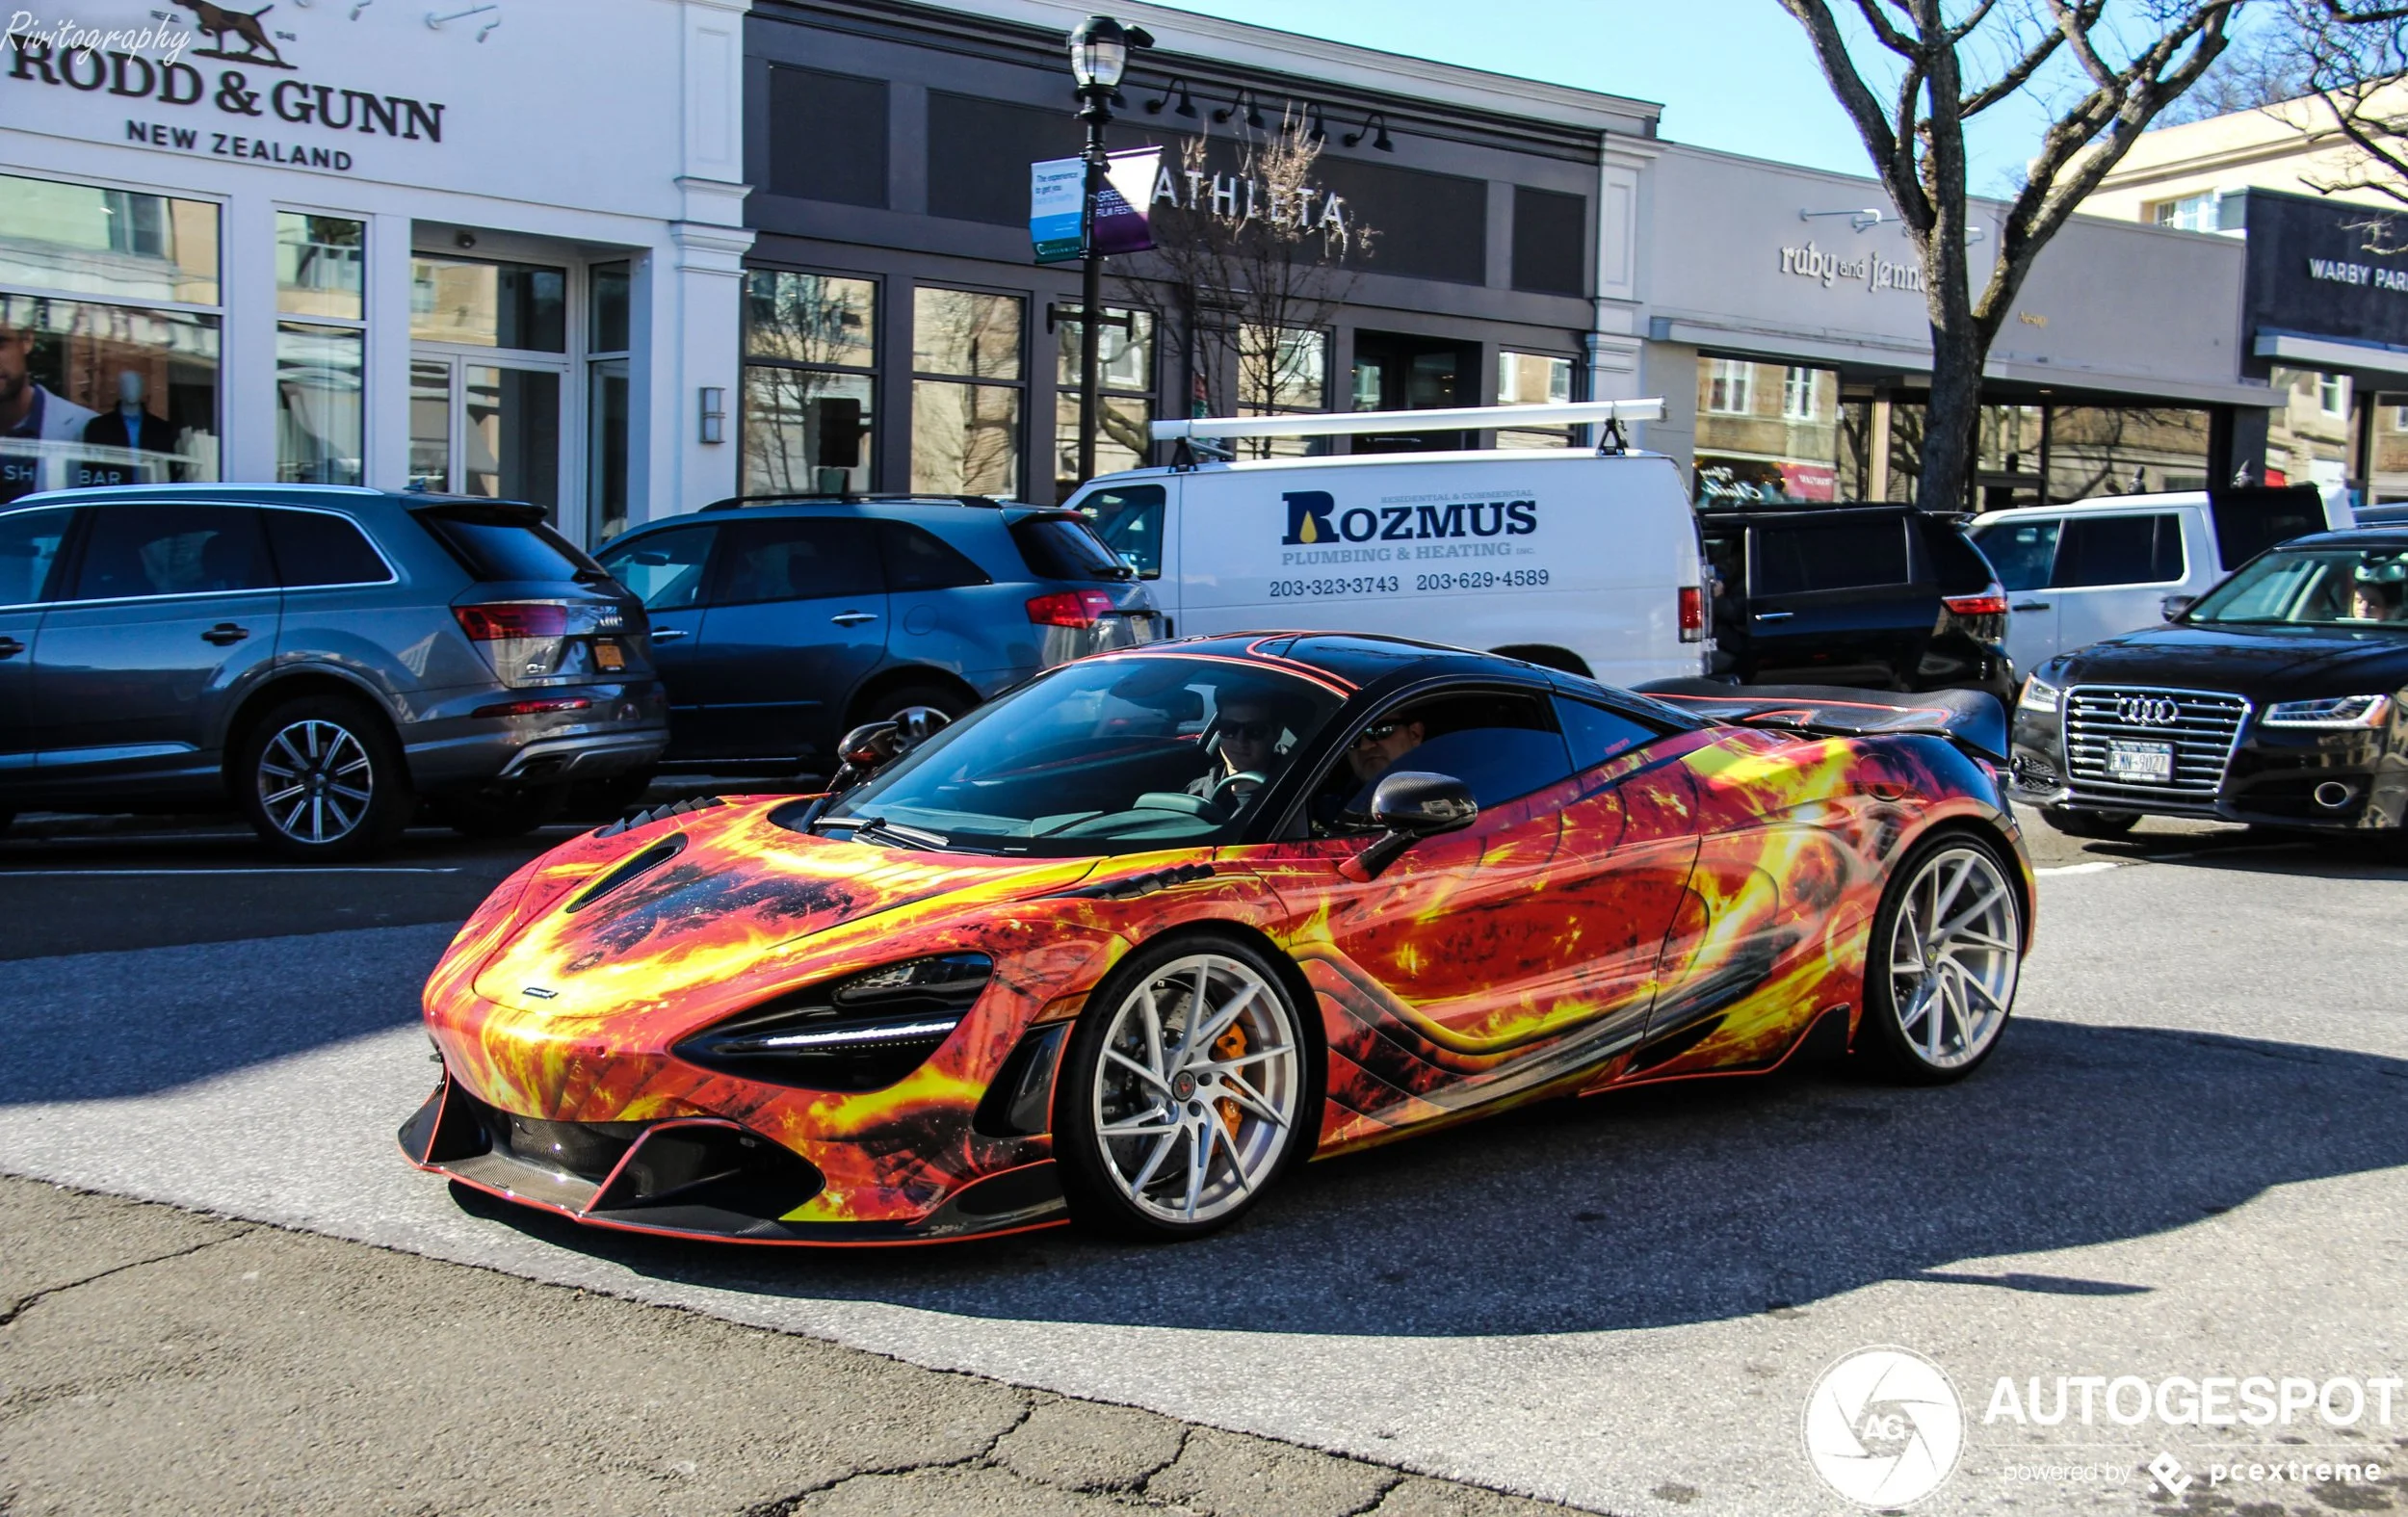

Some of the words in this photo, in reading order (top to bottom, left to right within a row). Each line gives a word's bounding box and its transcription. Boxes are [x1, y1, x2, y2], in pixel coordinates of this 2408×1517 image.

[9, 34, 204, 106] RODD
[214, 70, 262, 117] &
[272, 80, 445, 144] GUNN
[126, 119, 197, 149] NEW
[212, 133, 353, 171] ZEALAND
[1151, 166, 1347, 232] ATHLETA
[1781, 241, 1836, 288] ruby
[1839, 259, 1866, 279] and
[2309, 258, 2370, 286] WARBY
[2374, 268, 2408, 293] PAR
[79, 469, 122, 485] BAR
[1380, 493, 1450, 504] RESIDENTIAL
[1453, 492, 1460, 501] &
[1461, 489, 1533, 500] COMMERCIAL
[1282, 490, 1537, 545] ROZMUS
[1282, 547, 1392, 565] PLUMBING
[1397, 546, 1411, 561] &
[1416, 541, 1511, 560] HEATING
